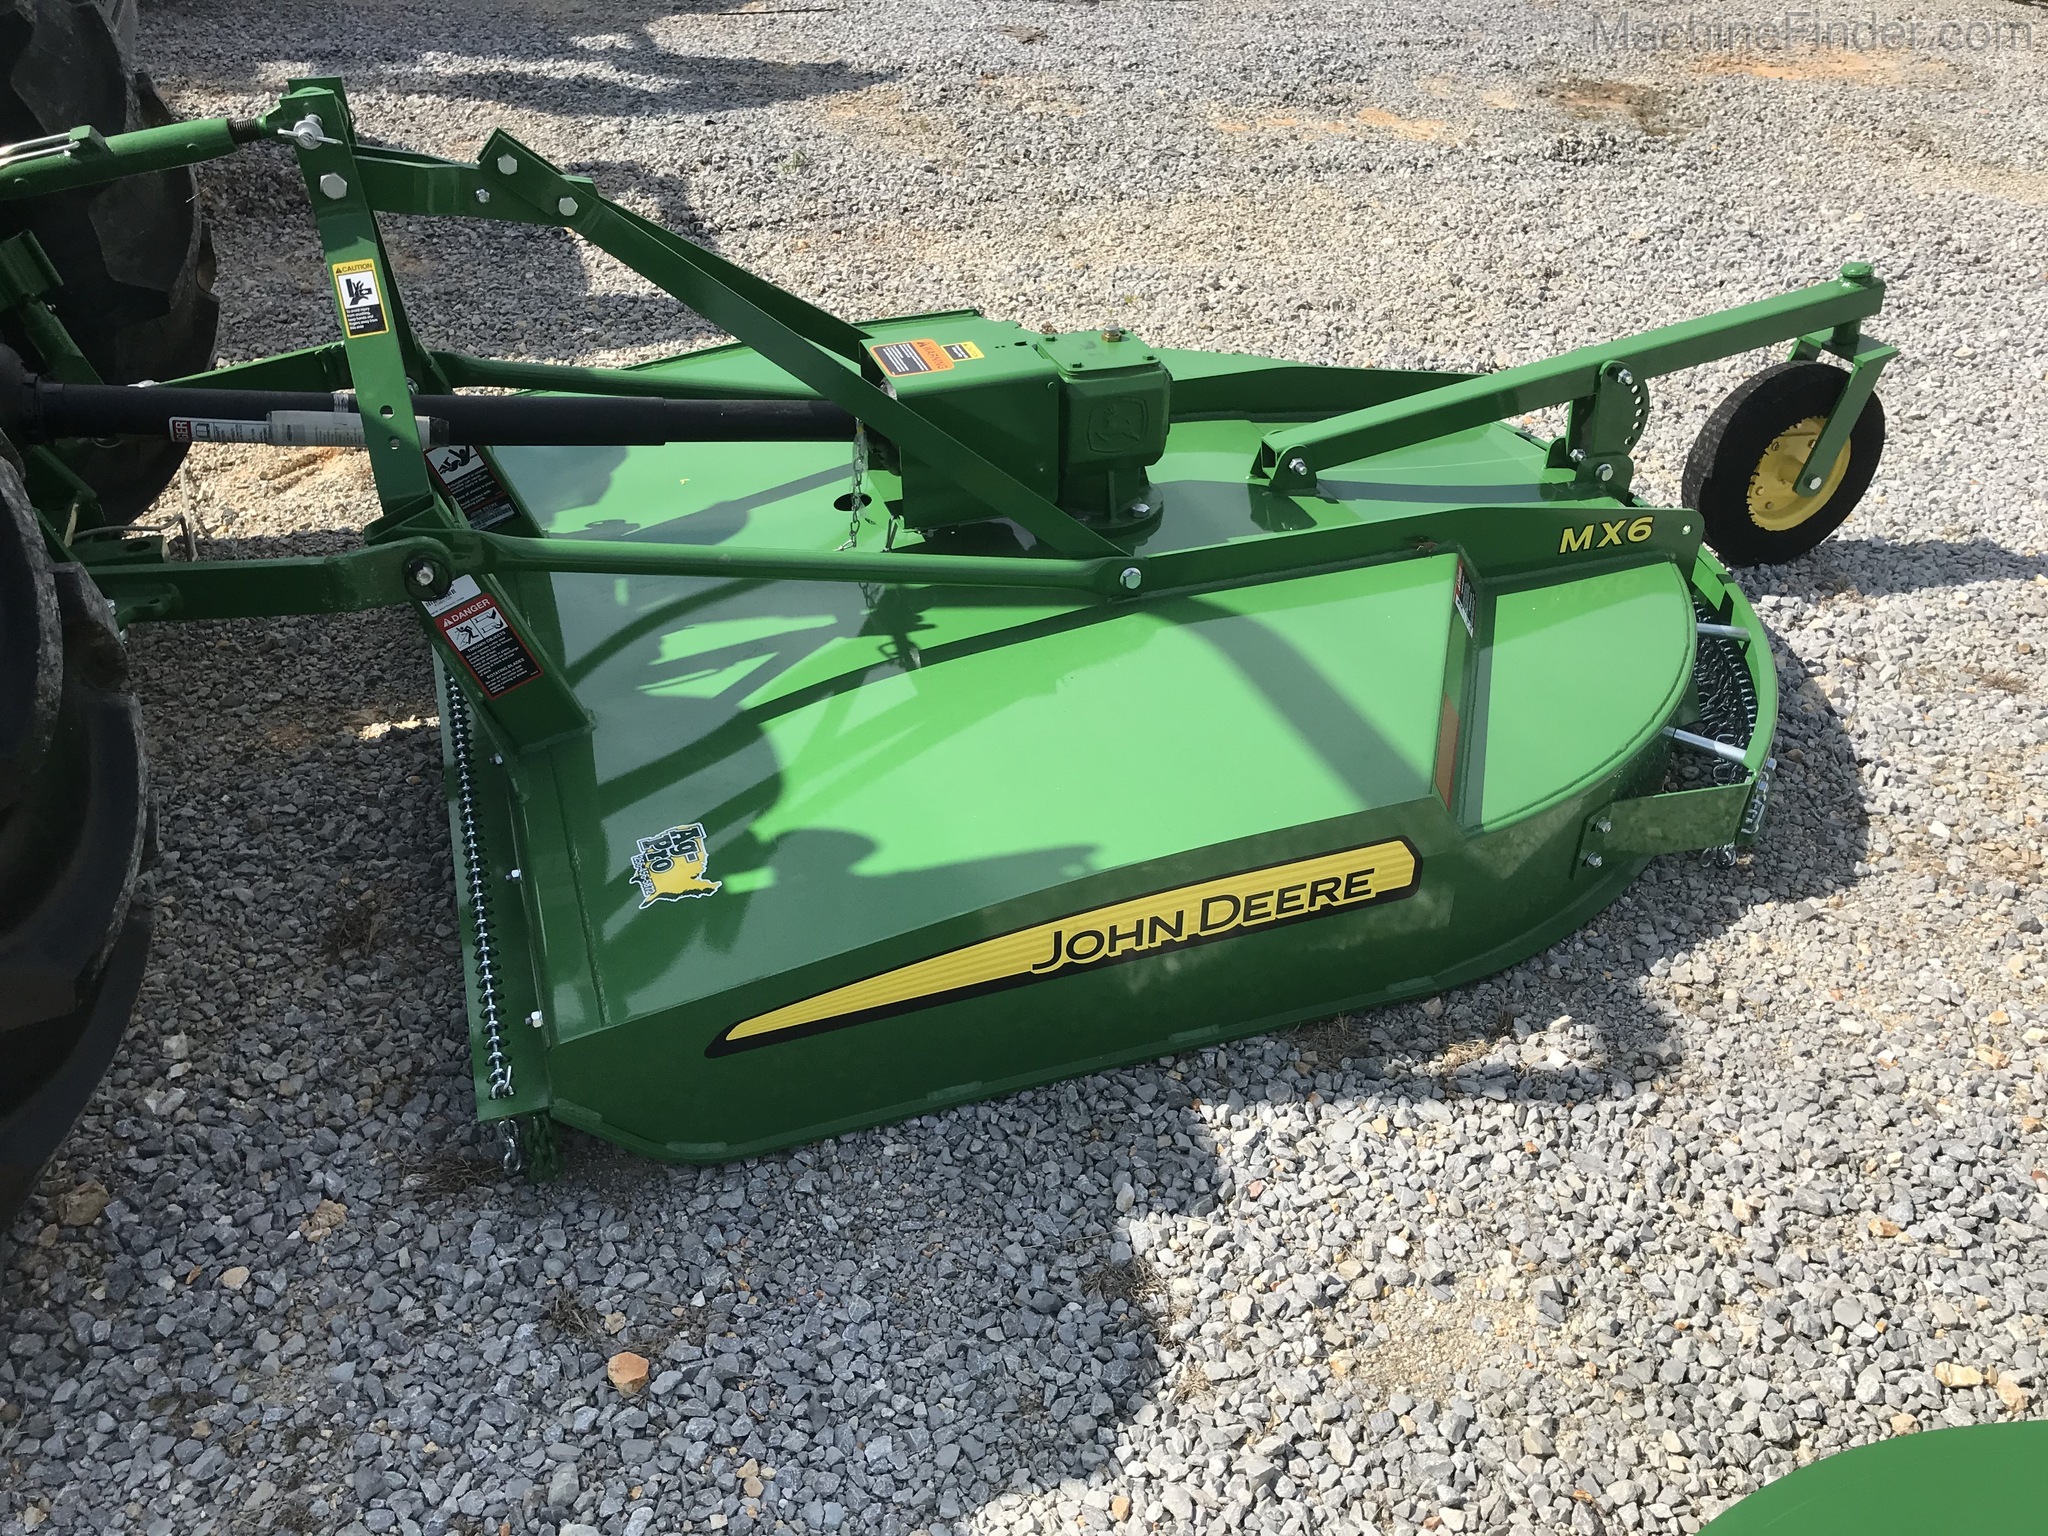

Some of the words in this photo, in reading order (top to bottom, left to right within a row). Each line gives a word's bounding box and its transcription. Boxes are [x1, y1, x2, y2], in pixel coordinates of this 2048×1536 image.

[341, 263, 373, 273] CAUTION
[1558, 515, 1655, 555] MX6
[450, 598, 491, 623] DANGER
[641, 833, 675, 873] Pro
[1031, 909, 1185, 971] JOHN
[1199, 867, 1375, 933] DEERE
